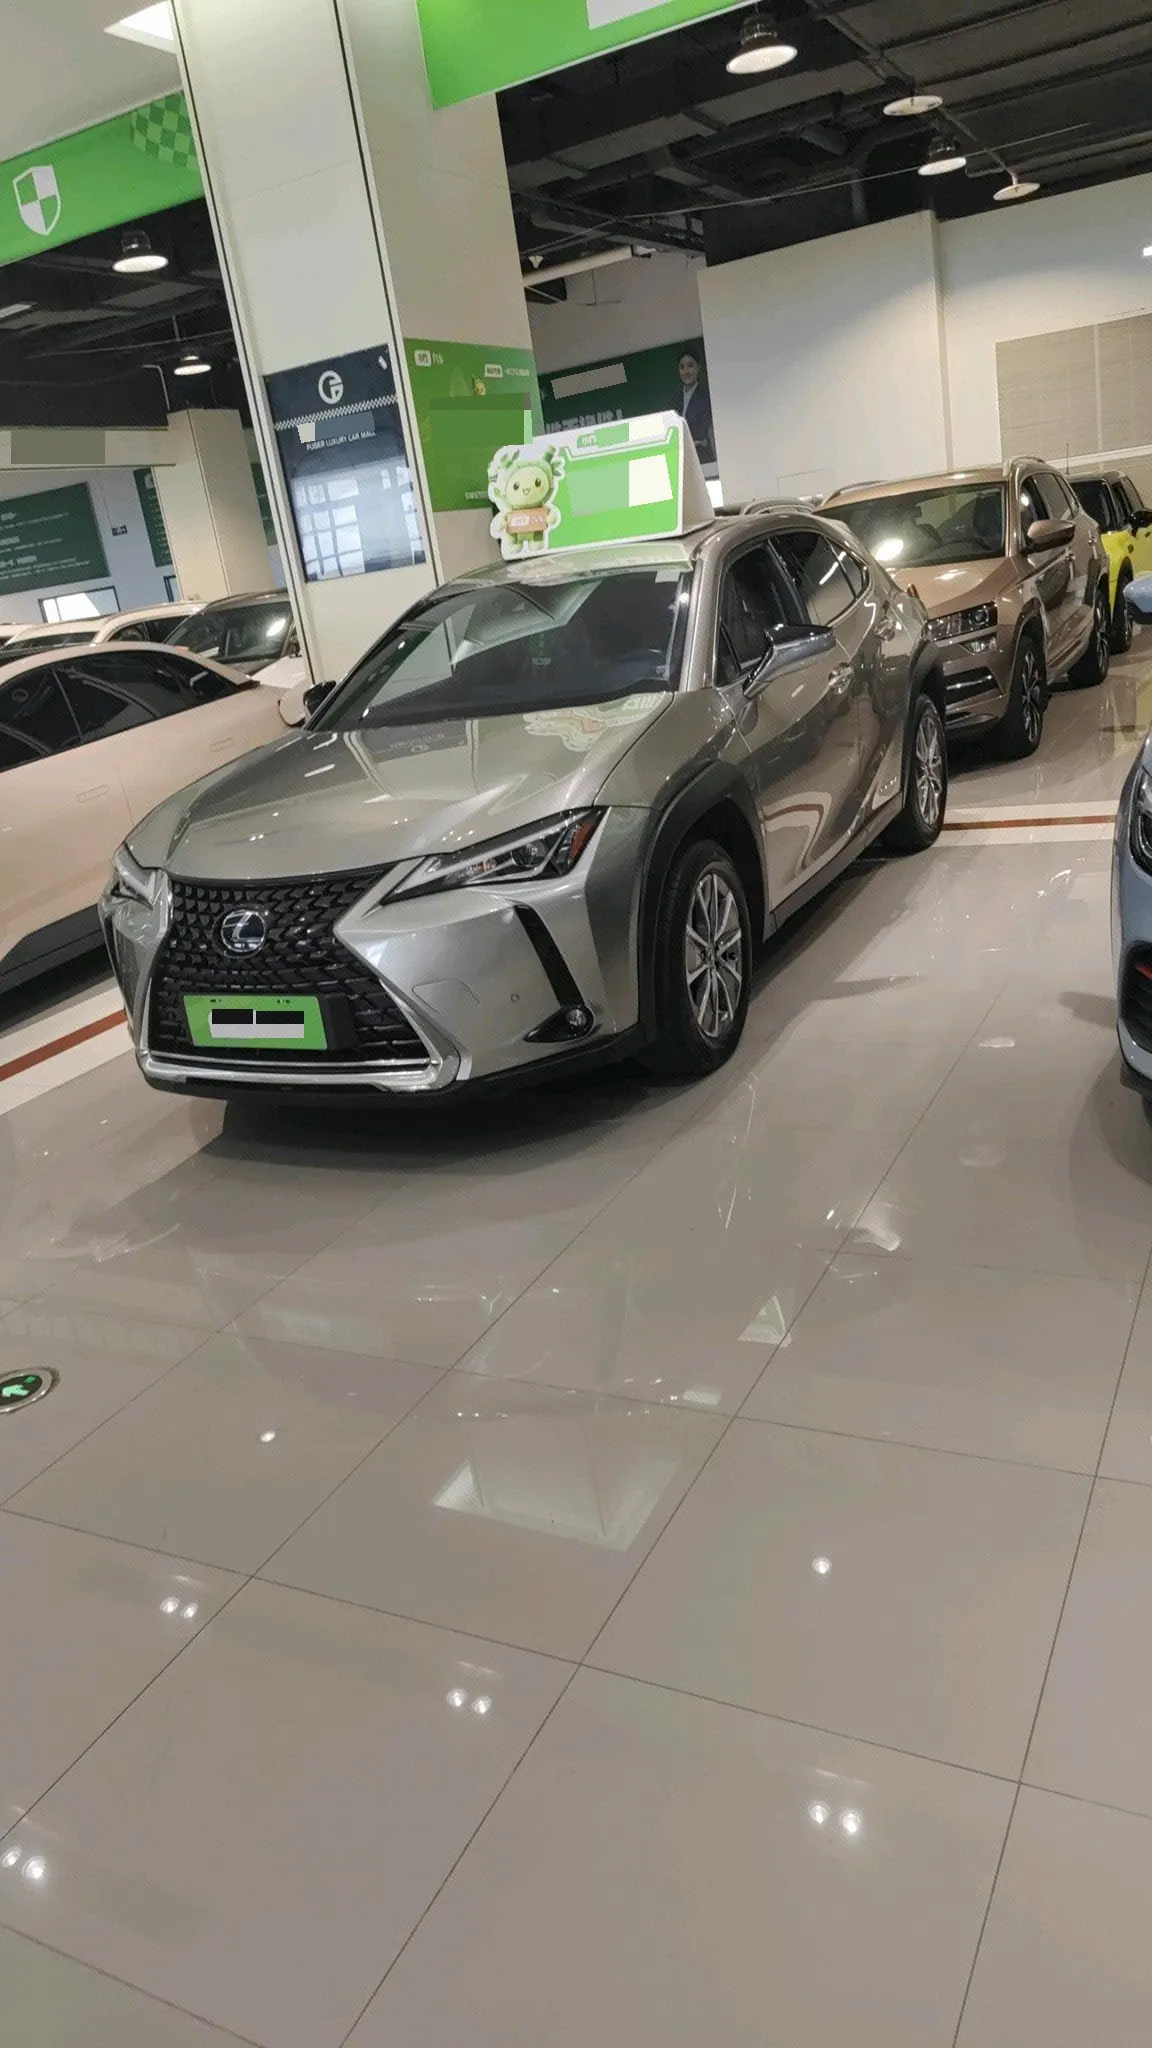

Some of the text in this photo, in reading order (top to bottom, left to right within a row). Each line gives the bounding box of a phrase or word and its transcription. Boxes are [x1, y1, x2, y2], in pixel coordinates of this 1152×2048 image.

[326, 436, 347, 446] LUXURY
[348, 432, 360, 441] CAR
[360, 430, 376, 438] MALL
